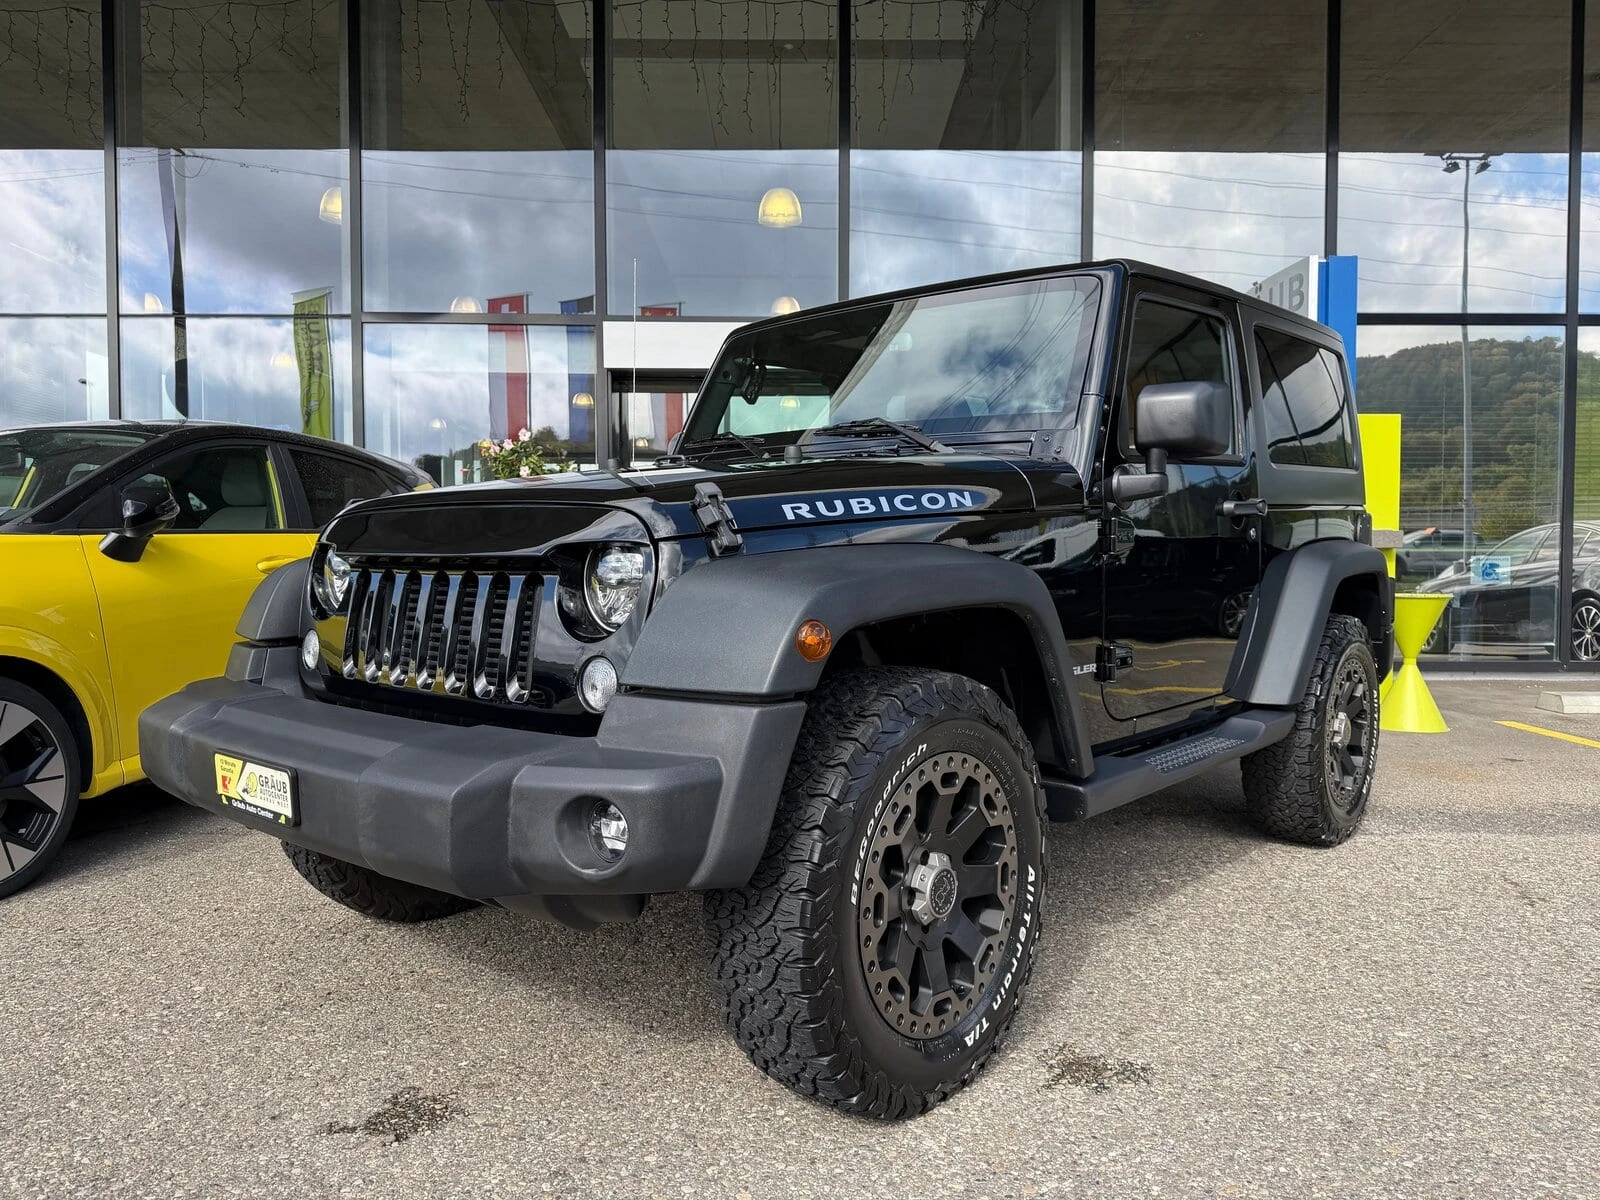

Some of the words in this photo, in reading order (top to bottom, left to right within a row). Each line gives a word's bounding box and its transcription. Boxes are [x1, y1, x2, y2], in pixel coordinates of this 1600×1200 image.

[781, 491, 973, 520] RUBICON
[259, 788, 289, 803] AUTOCENTER
[257, 808, 274, 819] Center
[851, 743, 927, 905] BFGoodrich
[992, 864, 1036, 1011] All-Terrain
[964, 1016, 990, 1047] T/A
